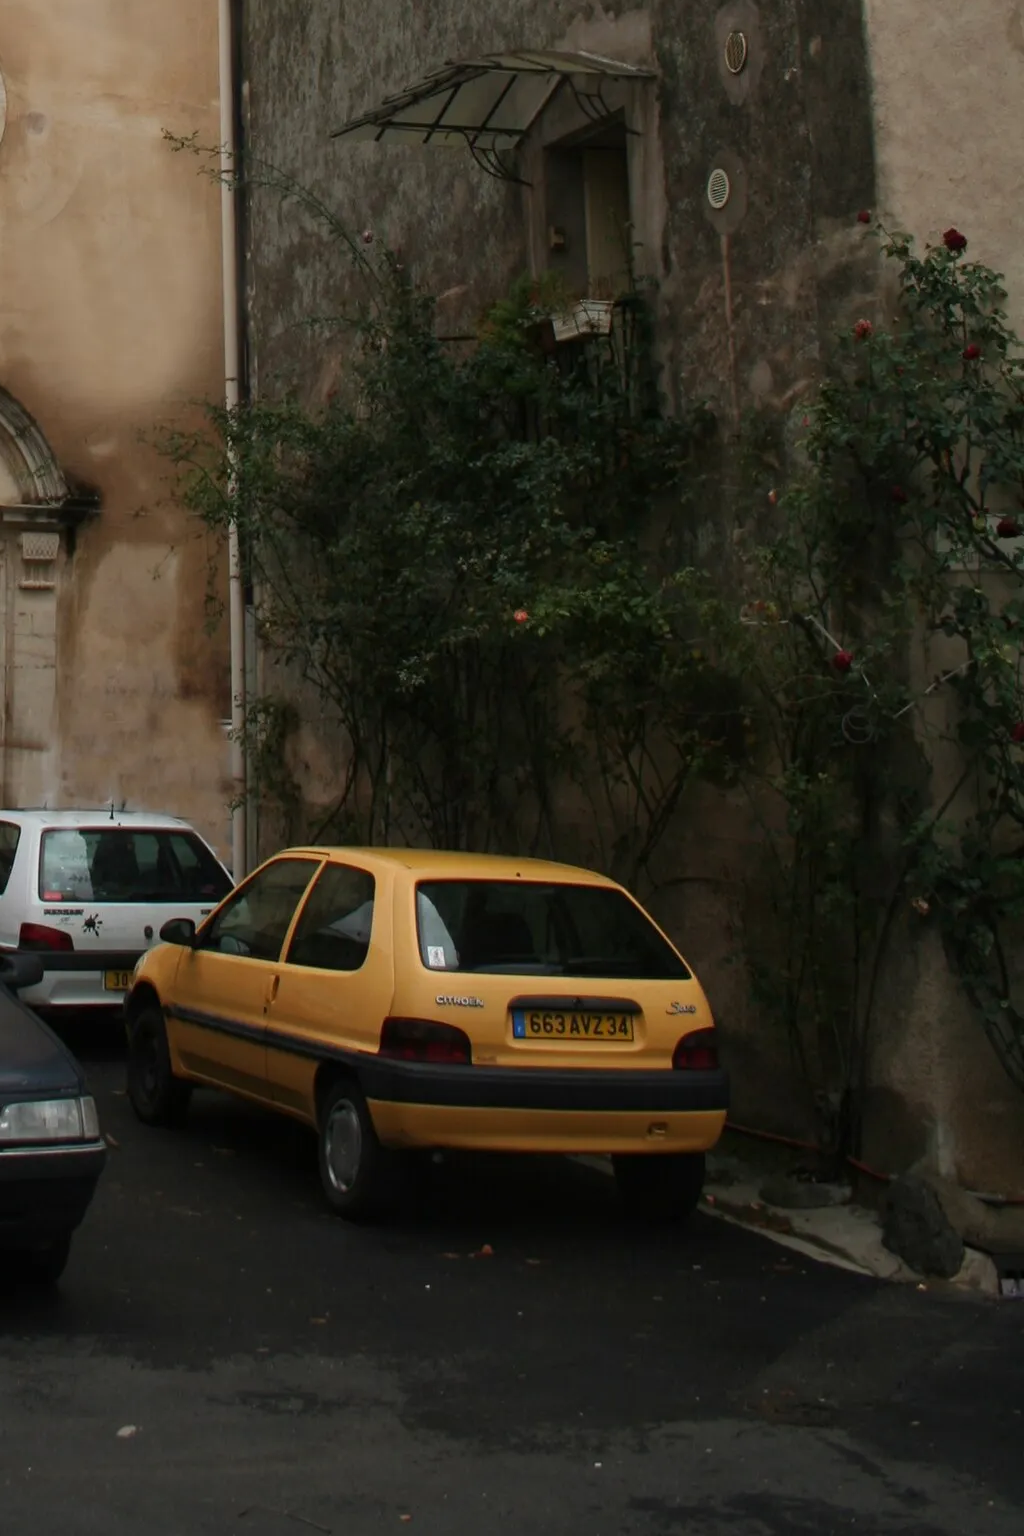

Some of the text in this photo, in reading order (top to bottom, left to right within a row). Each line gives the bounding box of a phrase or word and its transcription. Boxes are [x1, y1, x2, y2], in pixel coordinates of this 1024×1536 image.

[530, 1013, 628, 1036] 663 AVZ 34
